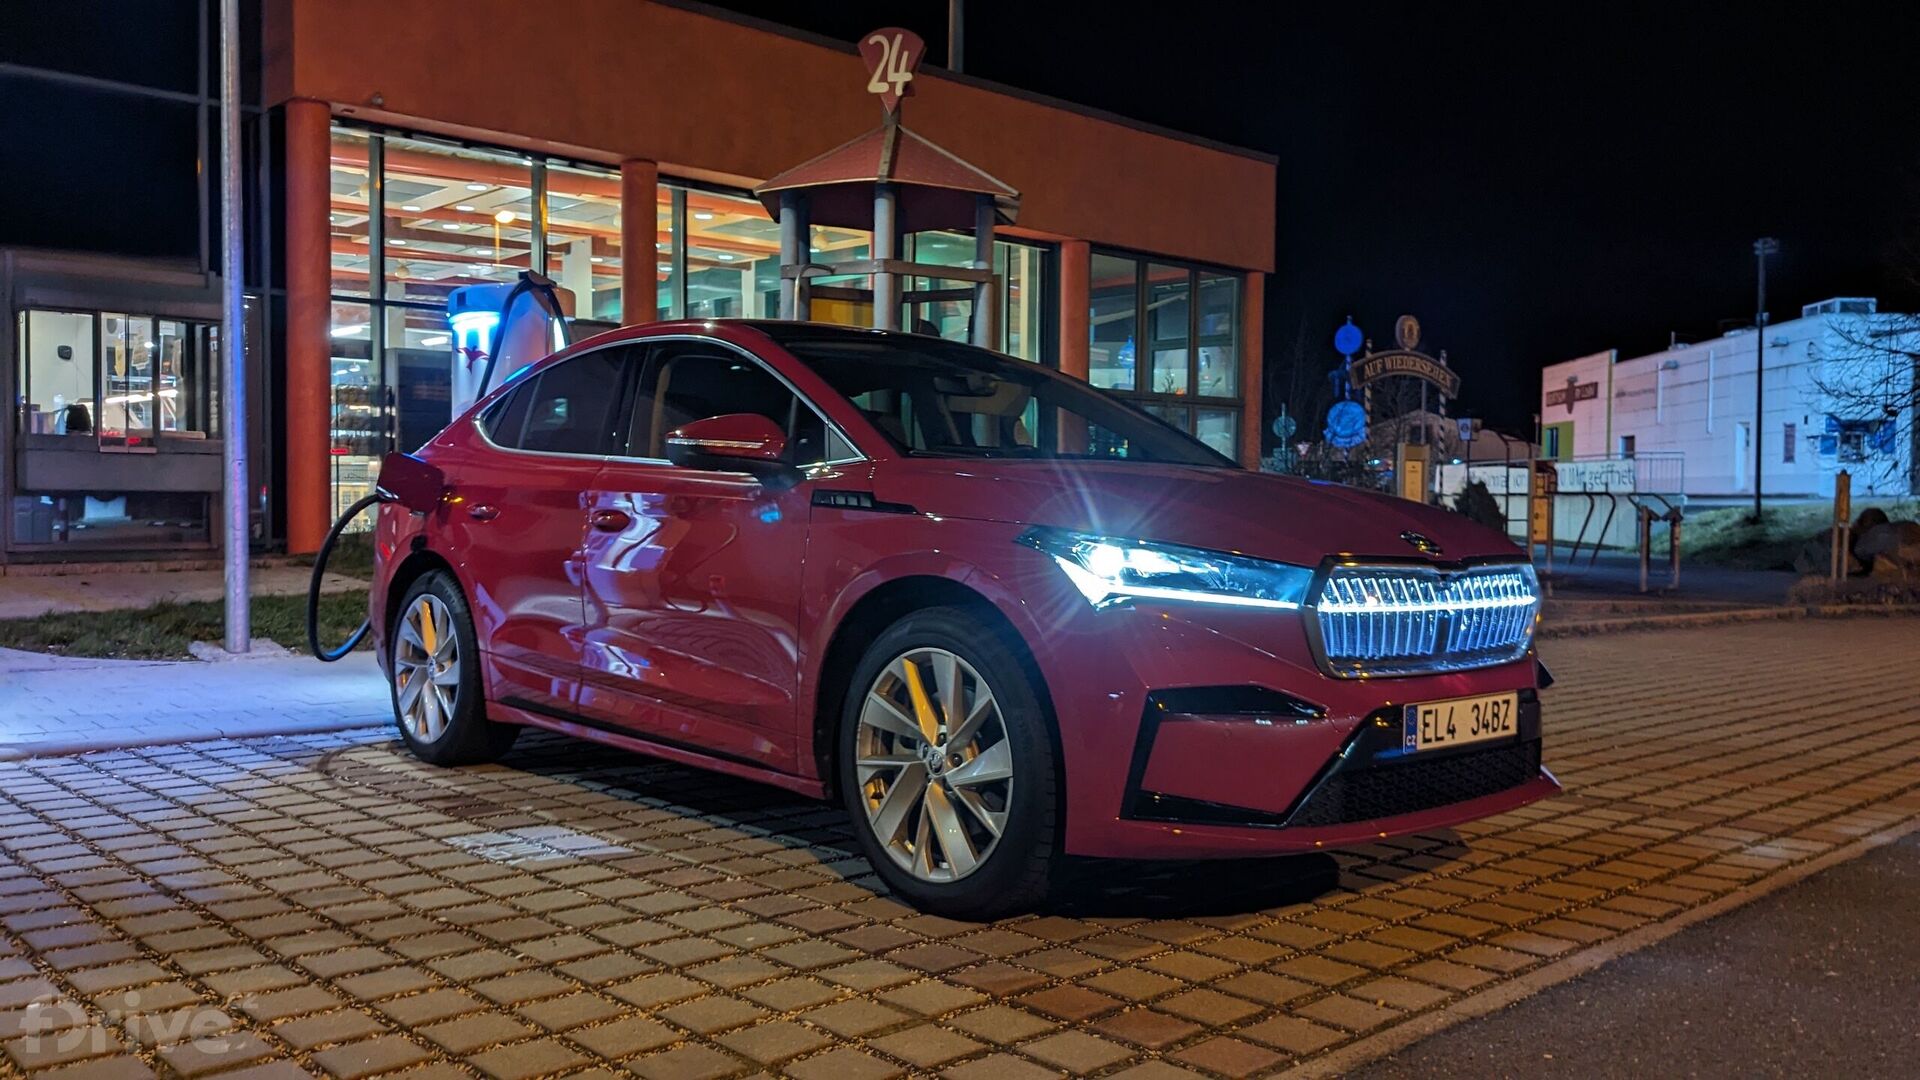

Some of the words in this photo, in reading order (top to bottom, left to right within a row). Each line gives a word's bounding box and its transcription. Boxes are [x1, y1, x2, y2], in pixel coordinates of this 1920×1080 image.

[867, 33, 913, 97] 24
[1364, 359, 1383, 379] AUF
[1422, 706, 1456, 744] EL4
[1471, 699, 1511, 736] 34BZ
[1406, 735, 1416, 746] CZ
